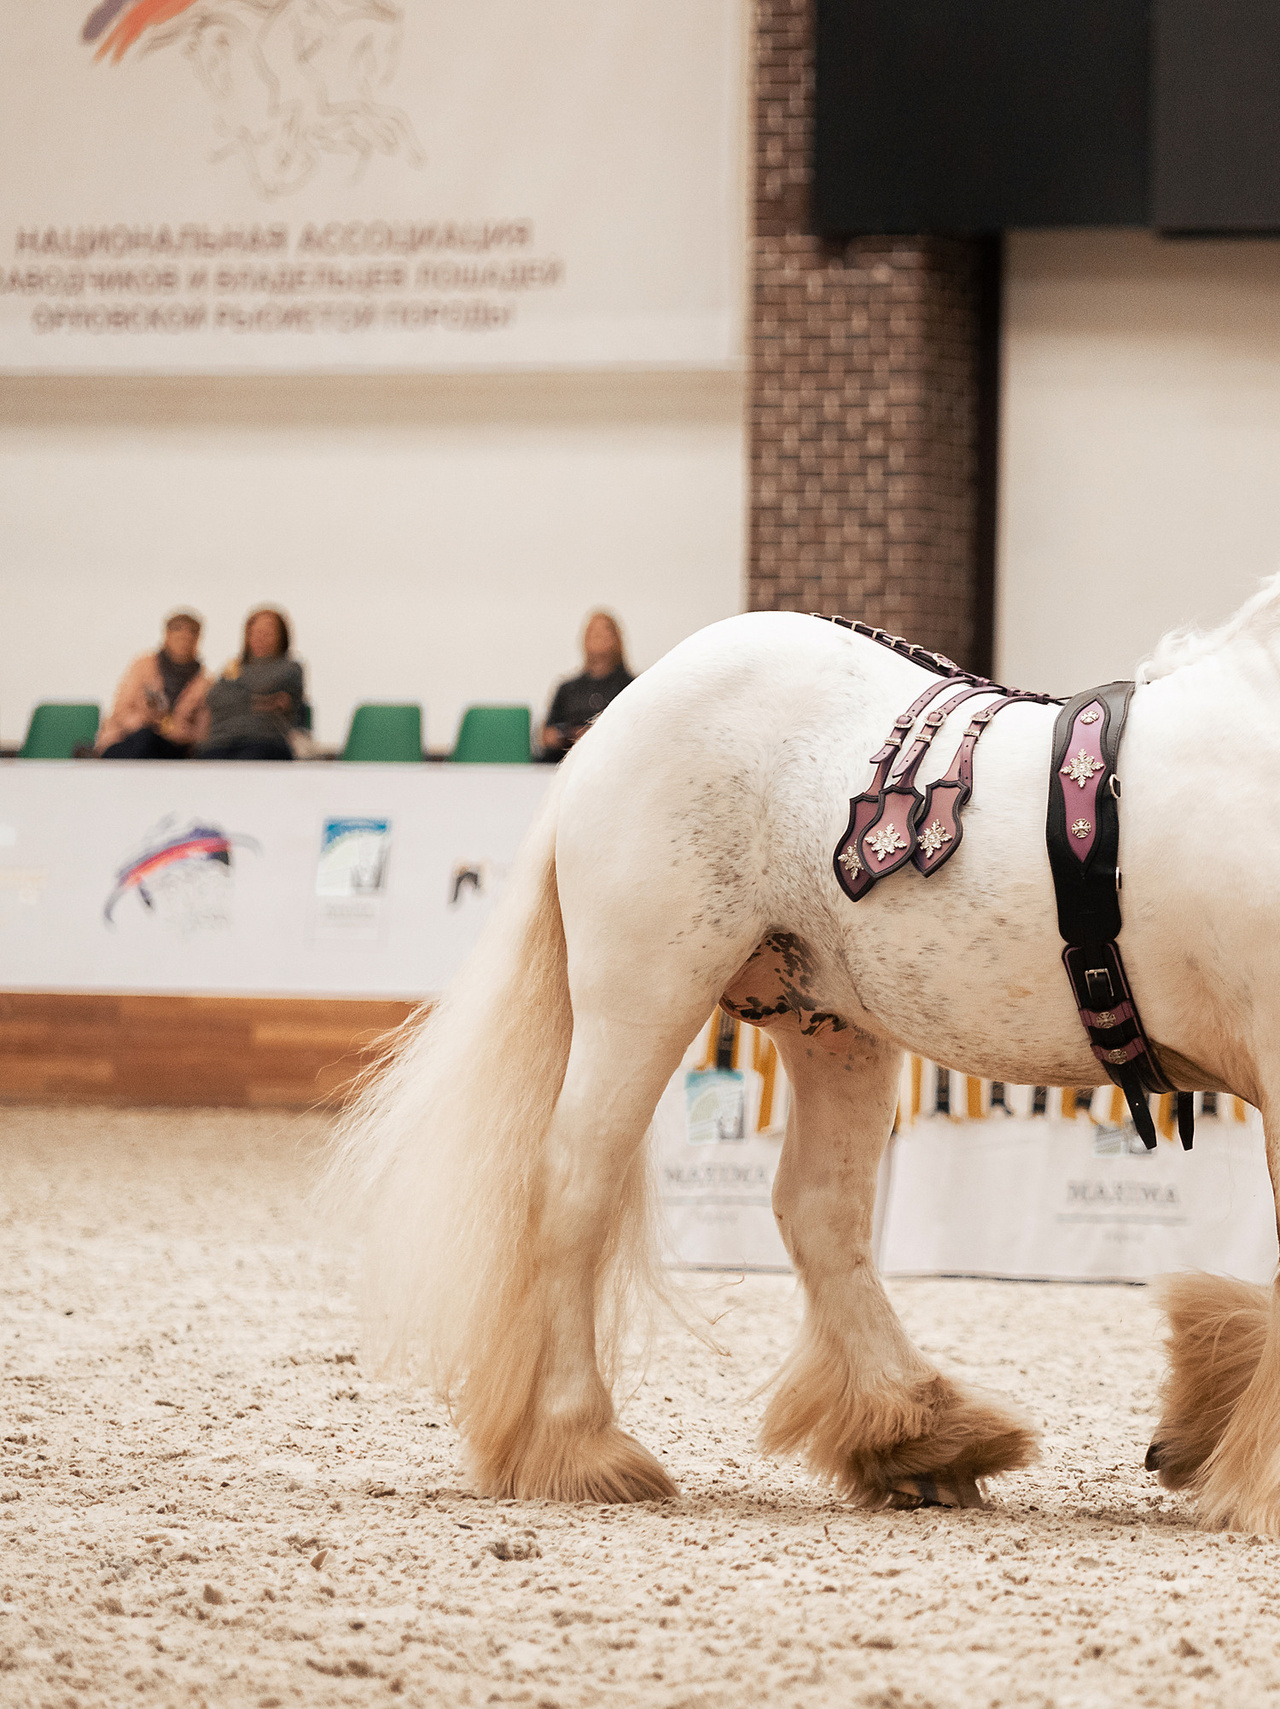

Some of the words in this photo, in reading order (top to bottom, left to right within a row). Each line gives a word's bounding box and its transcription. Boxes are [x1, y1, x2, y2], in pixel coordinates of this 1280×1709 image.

[14, 222, 290, 257] НАЦИОНАЛЬНАЯ
[298, 219, 532, 256] АССОЦИАЦИЯ
[0, 265, 180, 295] АВОДЧИКОВ
[186, 266, 208, 293] И
[214, 263, 407, 295] ВЛАДЕЛЬЦЕВ
[384, 301, 516, 332] ПОРОДЫ
